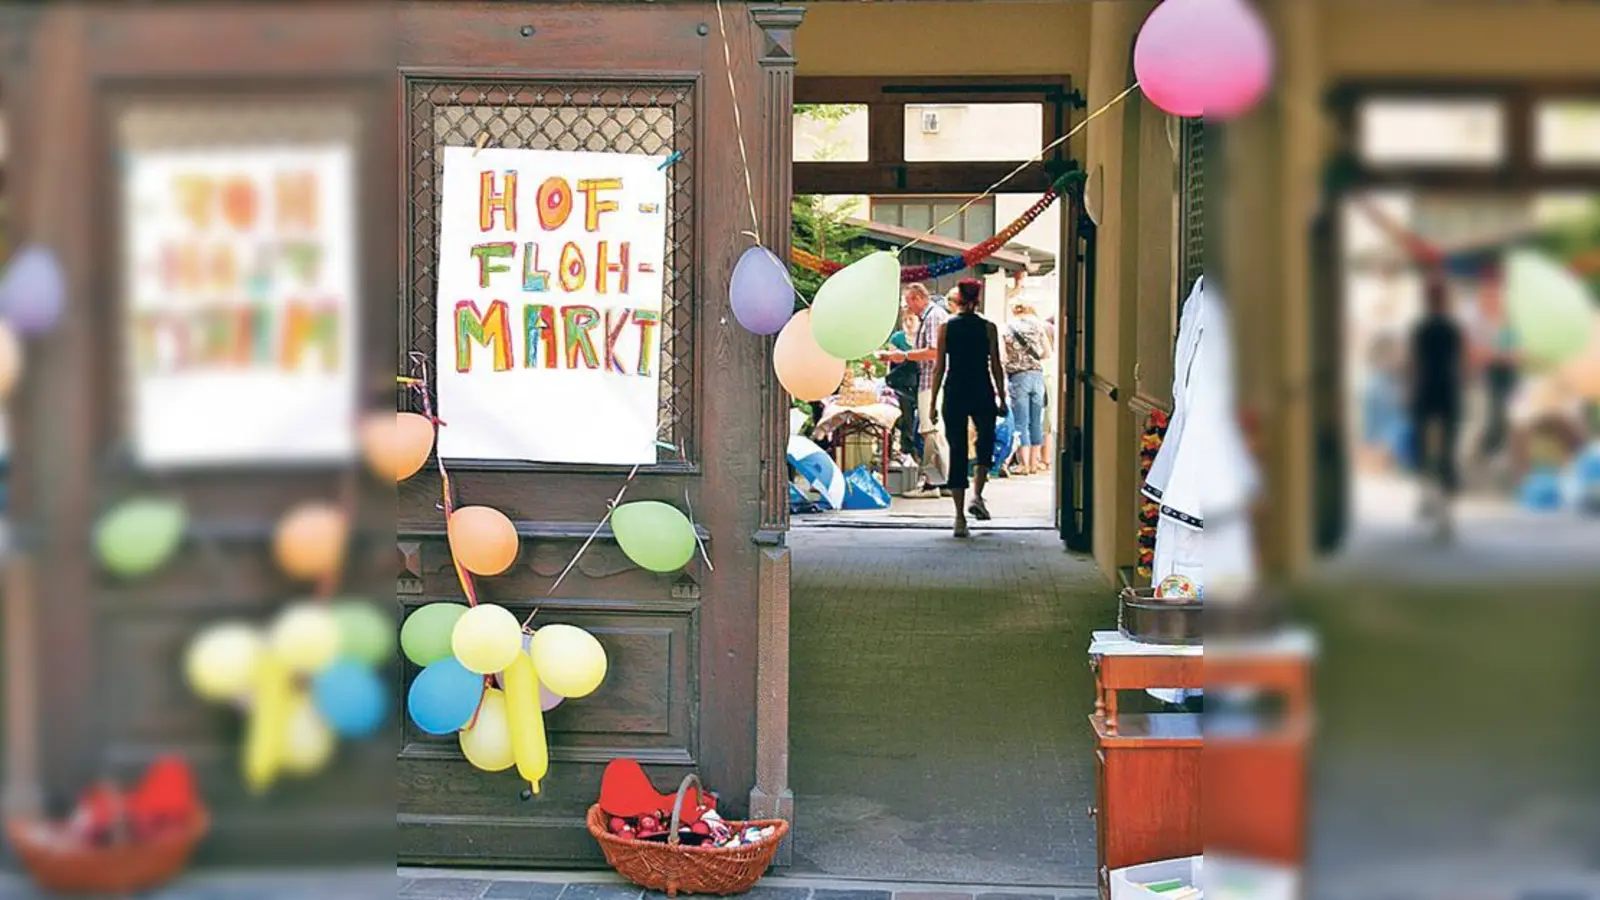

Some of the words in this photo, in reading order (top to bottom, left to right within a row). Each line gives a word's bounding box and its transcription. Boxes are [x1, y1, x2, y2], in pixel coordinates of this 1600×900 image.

[479, 169, 659, 232] HOF-
[470, 241, 656, 294] FLOH-
[454, 299, 661, 377] MARKT
